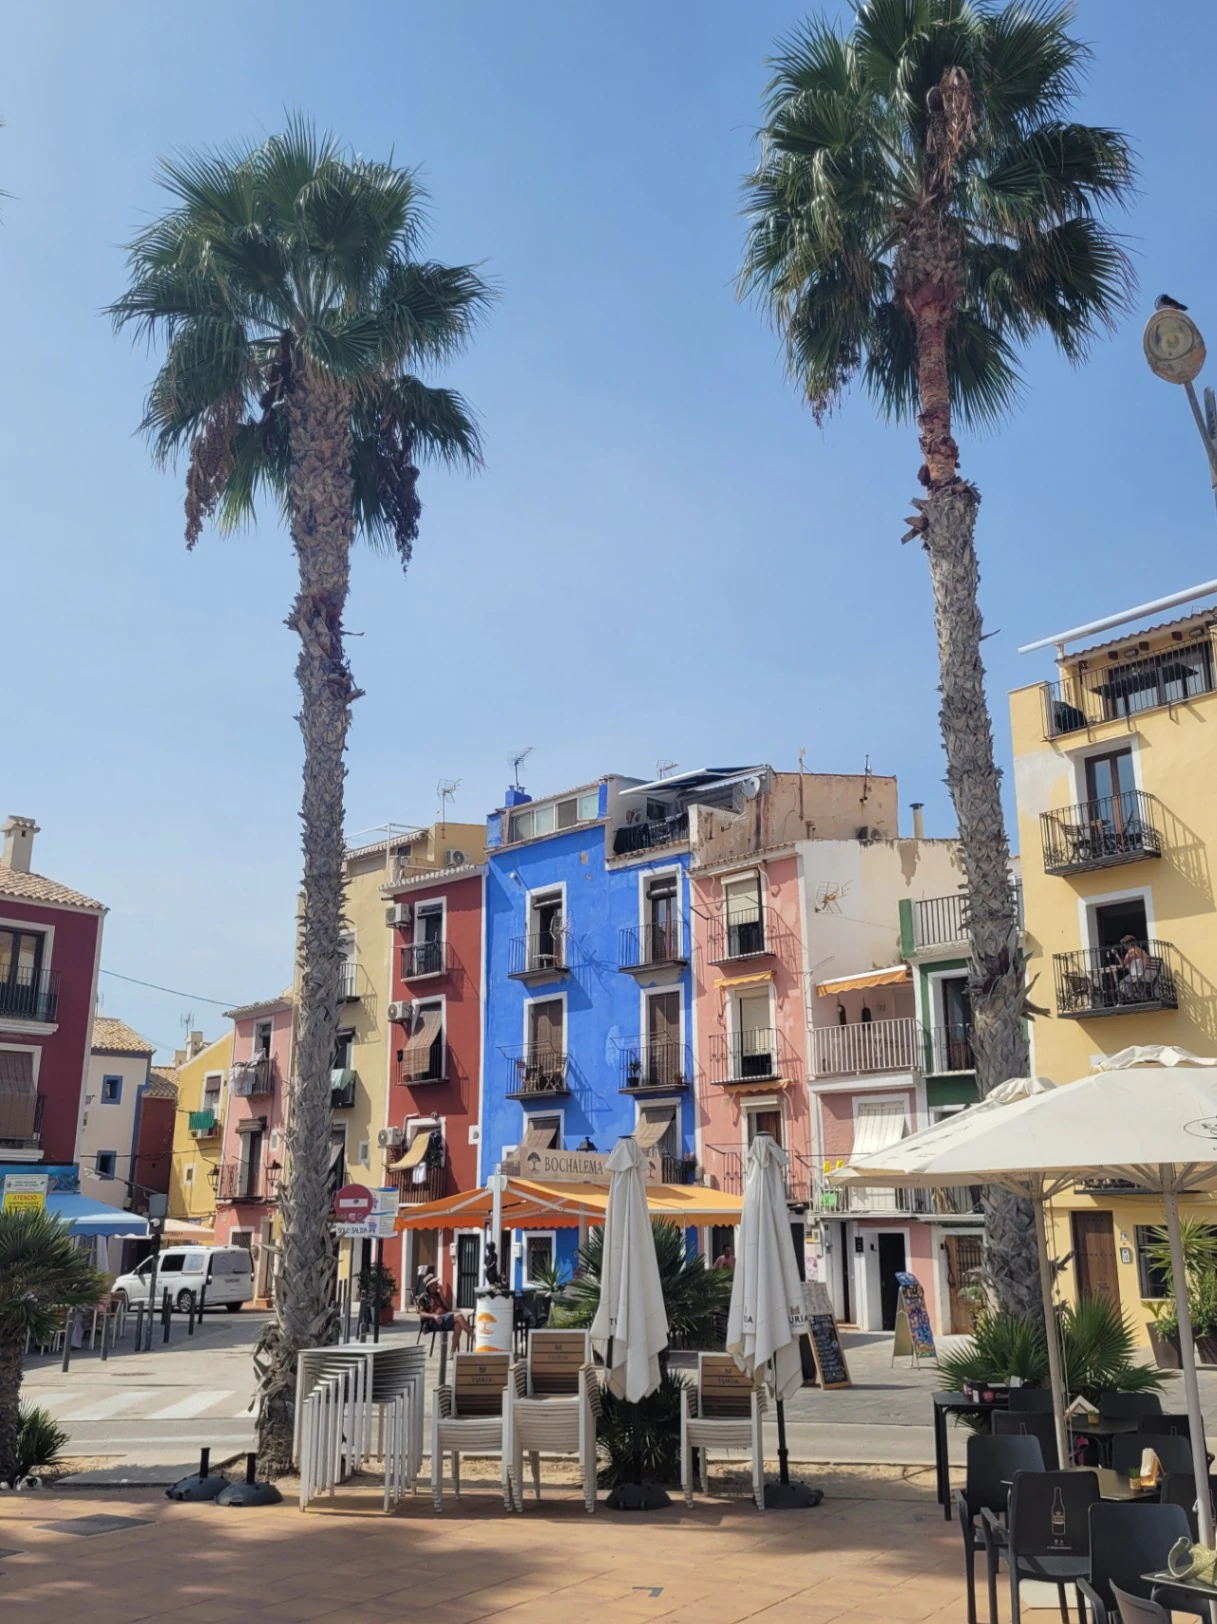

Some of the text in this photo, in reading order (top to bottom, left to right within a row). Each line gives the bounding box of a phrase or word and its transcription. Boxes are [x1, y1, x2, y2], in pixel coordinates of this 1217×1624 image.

[544, 1156, 604, 1176] BOCHALEMA
[351, 1226, 368, 1234] SALIDA
[788, 1314, 809, 1324] URIA
